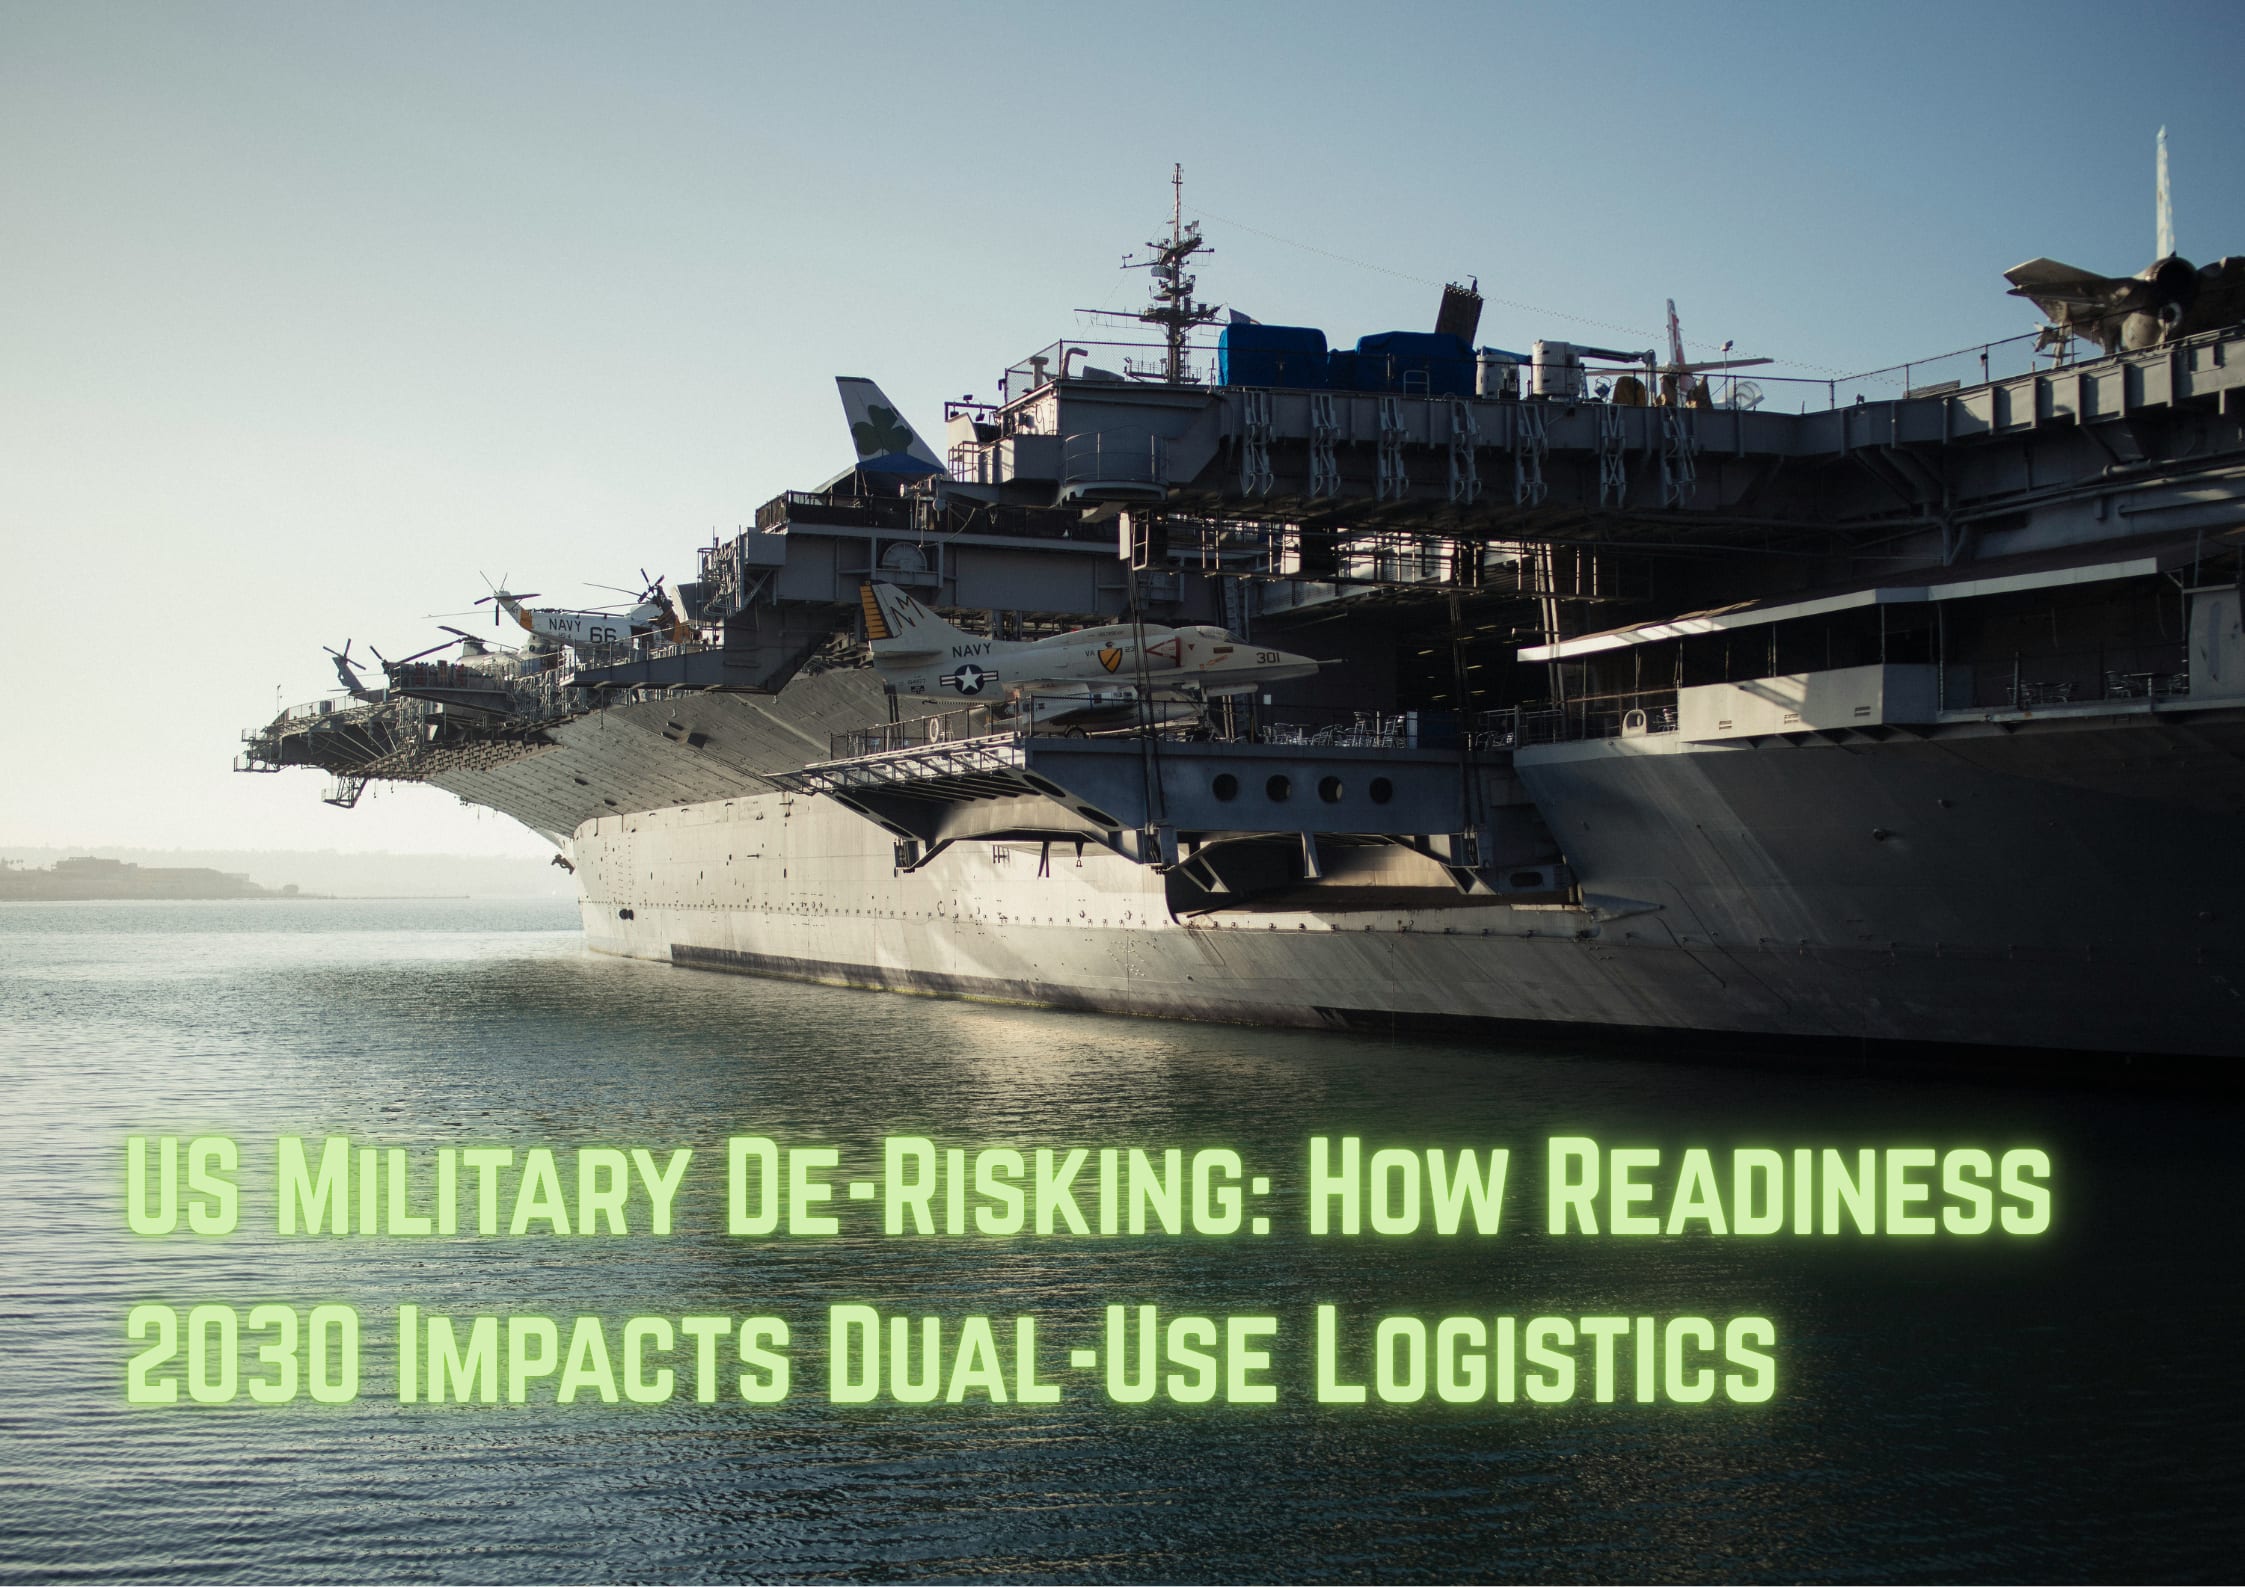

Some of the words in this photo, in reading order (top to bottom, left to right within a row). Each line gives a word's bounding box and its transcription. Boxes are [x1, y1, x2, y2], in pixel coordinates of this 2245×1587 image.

[549, 617, 581, 633] NAVY
[590, 626, 617, 644] 66
[952, 642, 992, 658] NAVY
[1256, 652, 1280, 664] 301
